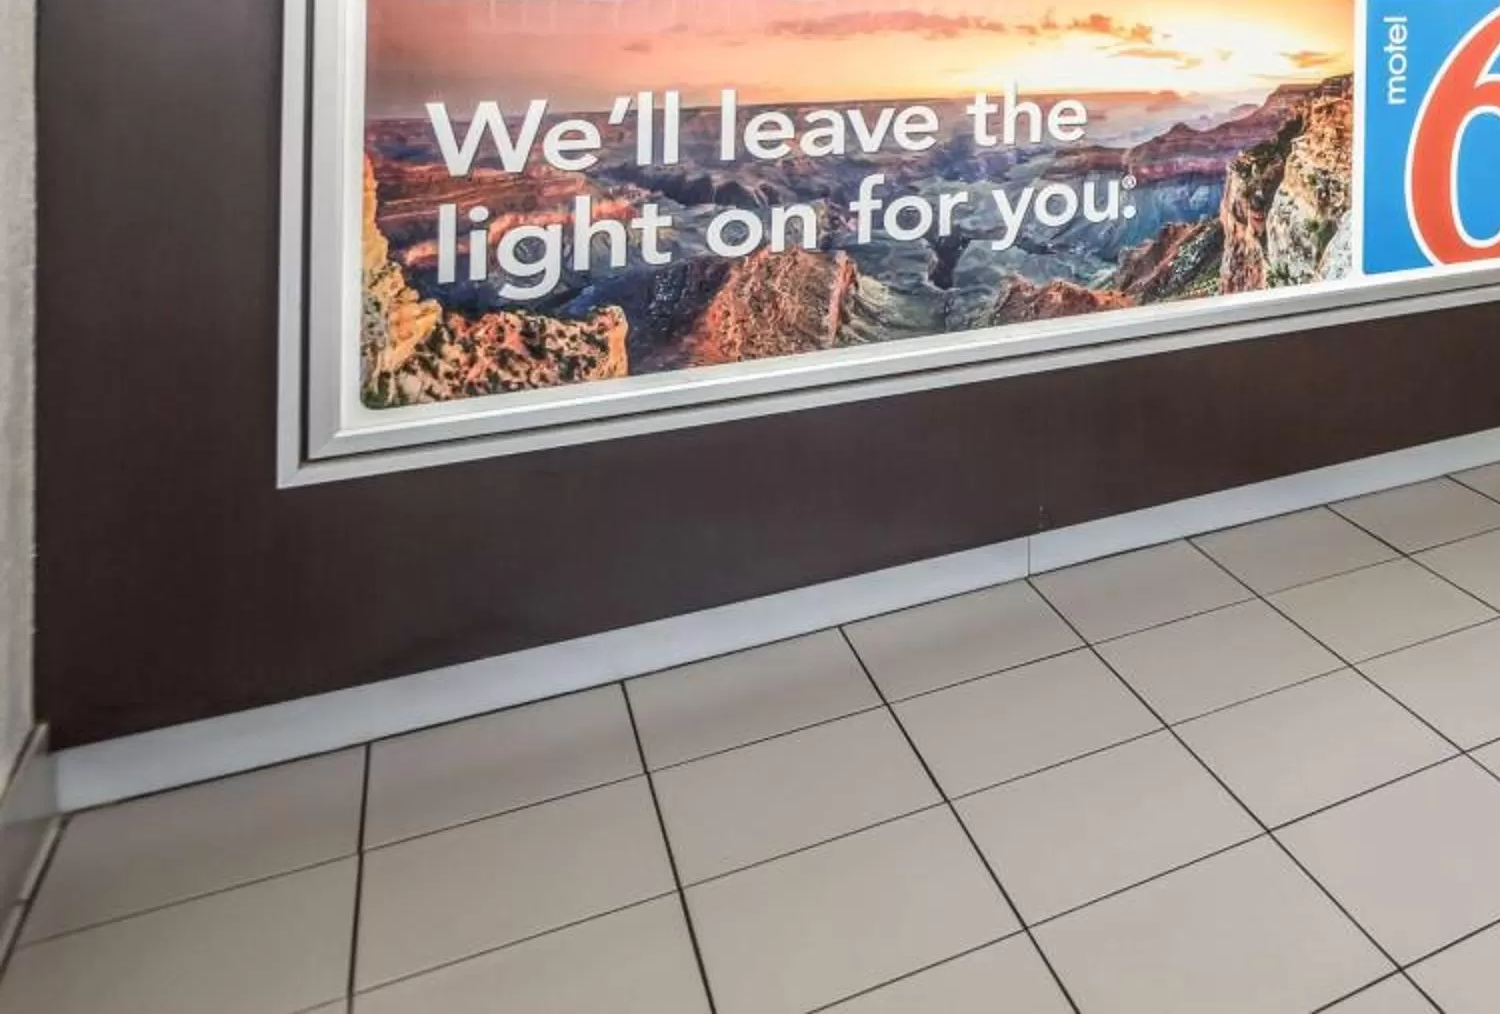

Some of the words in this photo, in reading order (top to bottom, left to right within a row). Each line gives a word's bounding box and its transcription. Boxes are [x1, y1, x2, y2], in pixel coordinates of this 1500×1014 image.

[1384, 15, 1408, 105] motel
[719, 89, 939, 161] leave
[967, 87, 1088, 147] the
[436, 196, 672, 300] light
[706, 204, 817, 258] on
[849, 174, 968, 244] for
